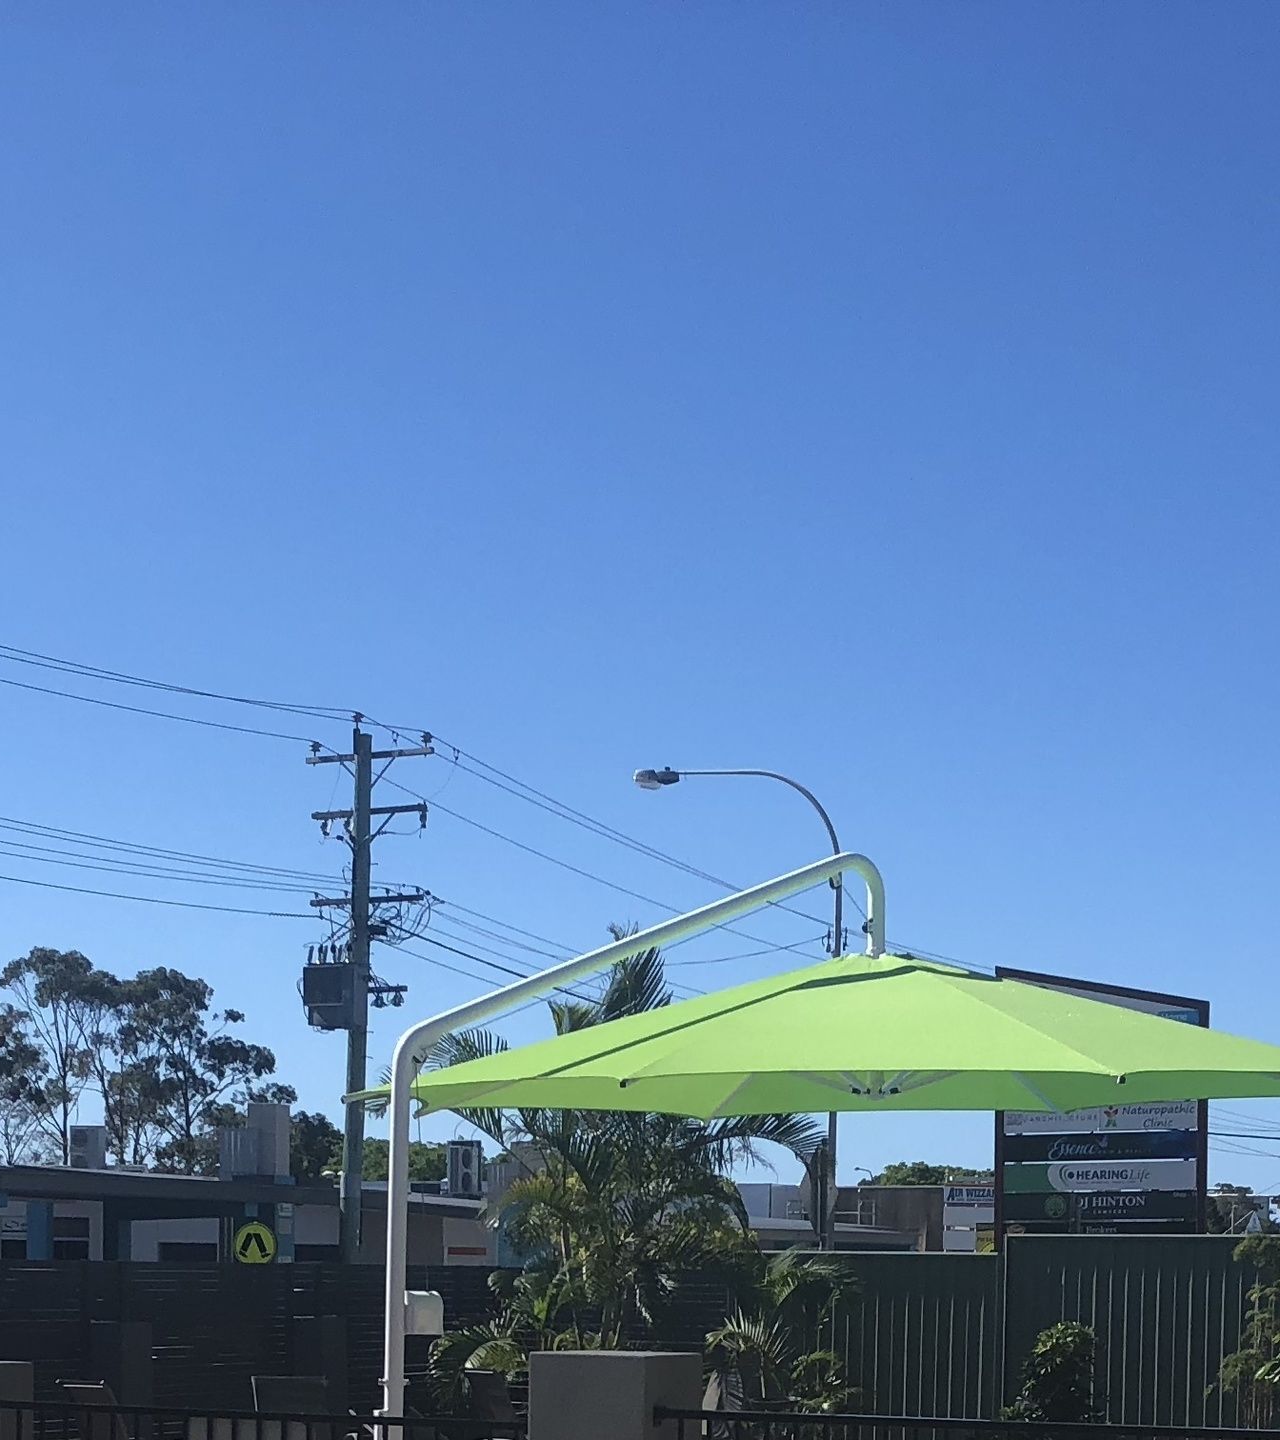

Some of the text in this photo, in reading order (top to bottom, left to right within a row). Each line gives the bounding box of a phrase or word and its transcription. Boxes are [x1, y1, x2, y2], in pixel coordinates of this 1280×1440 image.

[1122, 1104, 1195, 1116] Naturopathic
[1143, 1118, 1174, 1128] Clinic
[1048, 1137, 1096, 1160] Essence
[1092, 1196, 1146, 1207] HINTON
